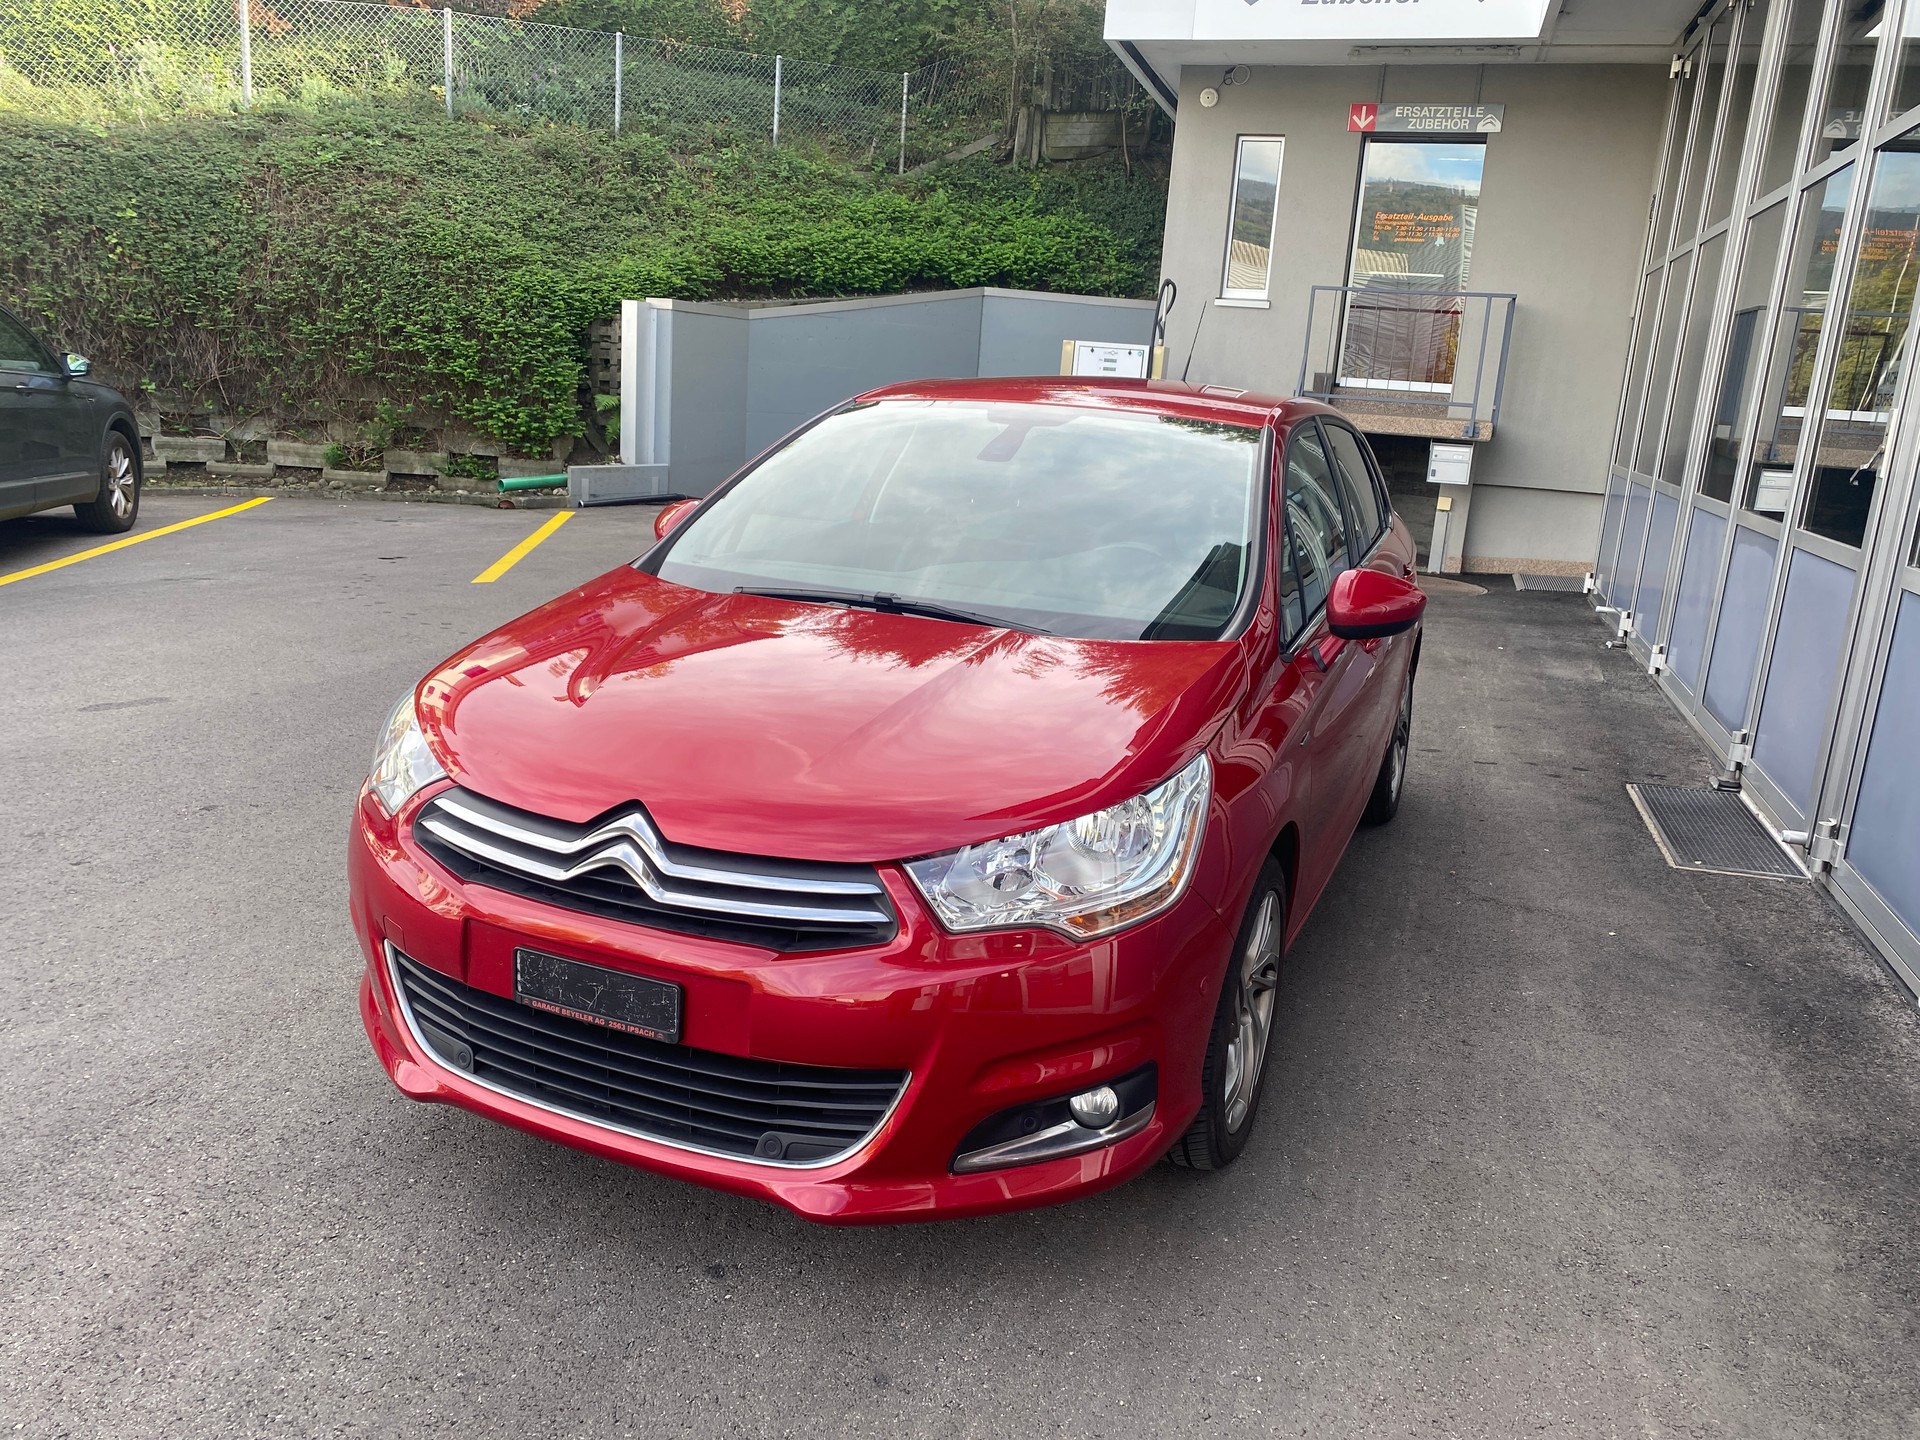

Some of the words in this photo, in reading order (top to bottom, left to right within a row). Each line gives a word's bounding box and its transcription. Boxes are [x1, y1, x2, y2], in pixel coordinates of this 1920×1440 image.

[1395, 106, 1485, 118] ERSATZTEILE
[1407, 117, 1470, 130] ZUBEHÖR
[1375, 211, 1454, 223] Ersatzteil-Ausgabe
[531, 1000, 560, 1014] GARAGE
[561, 1008, 593, 1023] BEYELER
[594, 1017, 605, 1026] AG
[608, 1020, 626, 1031] 2563
[627, 1025, 655, 1038] IPSACH
